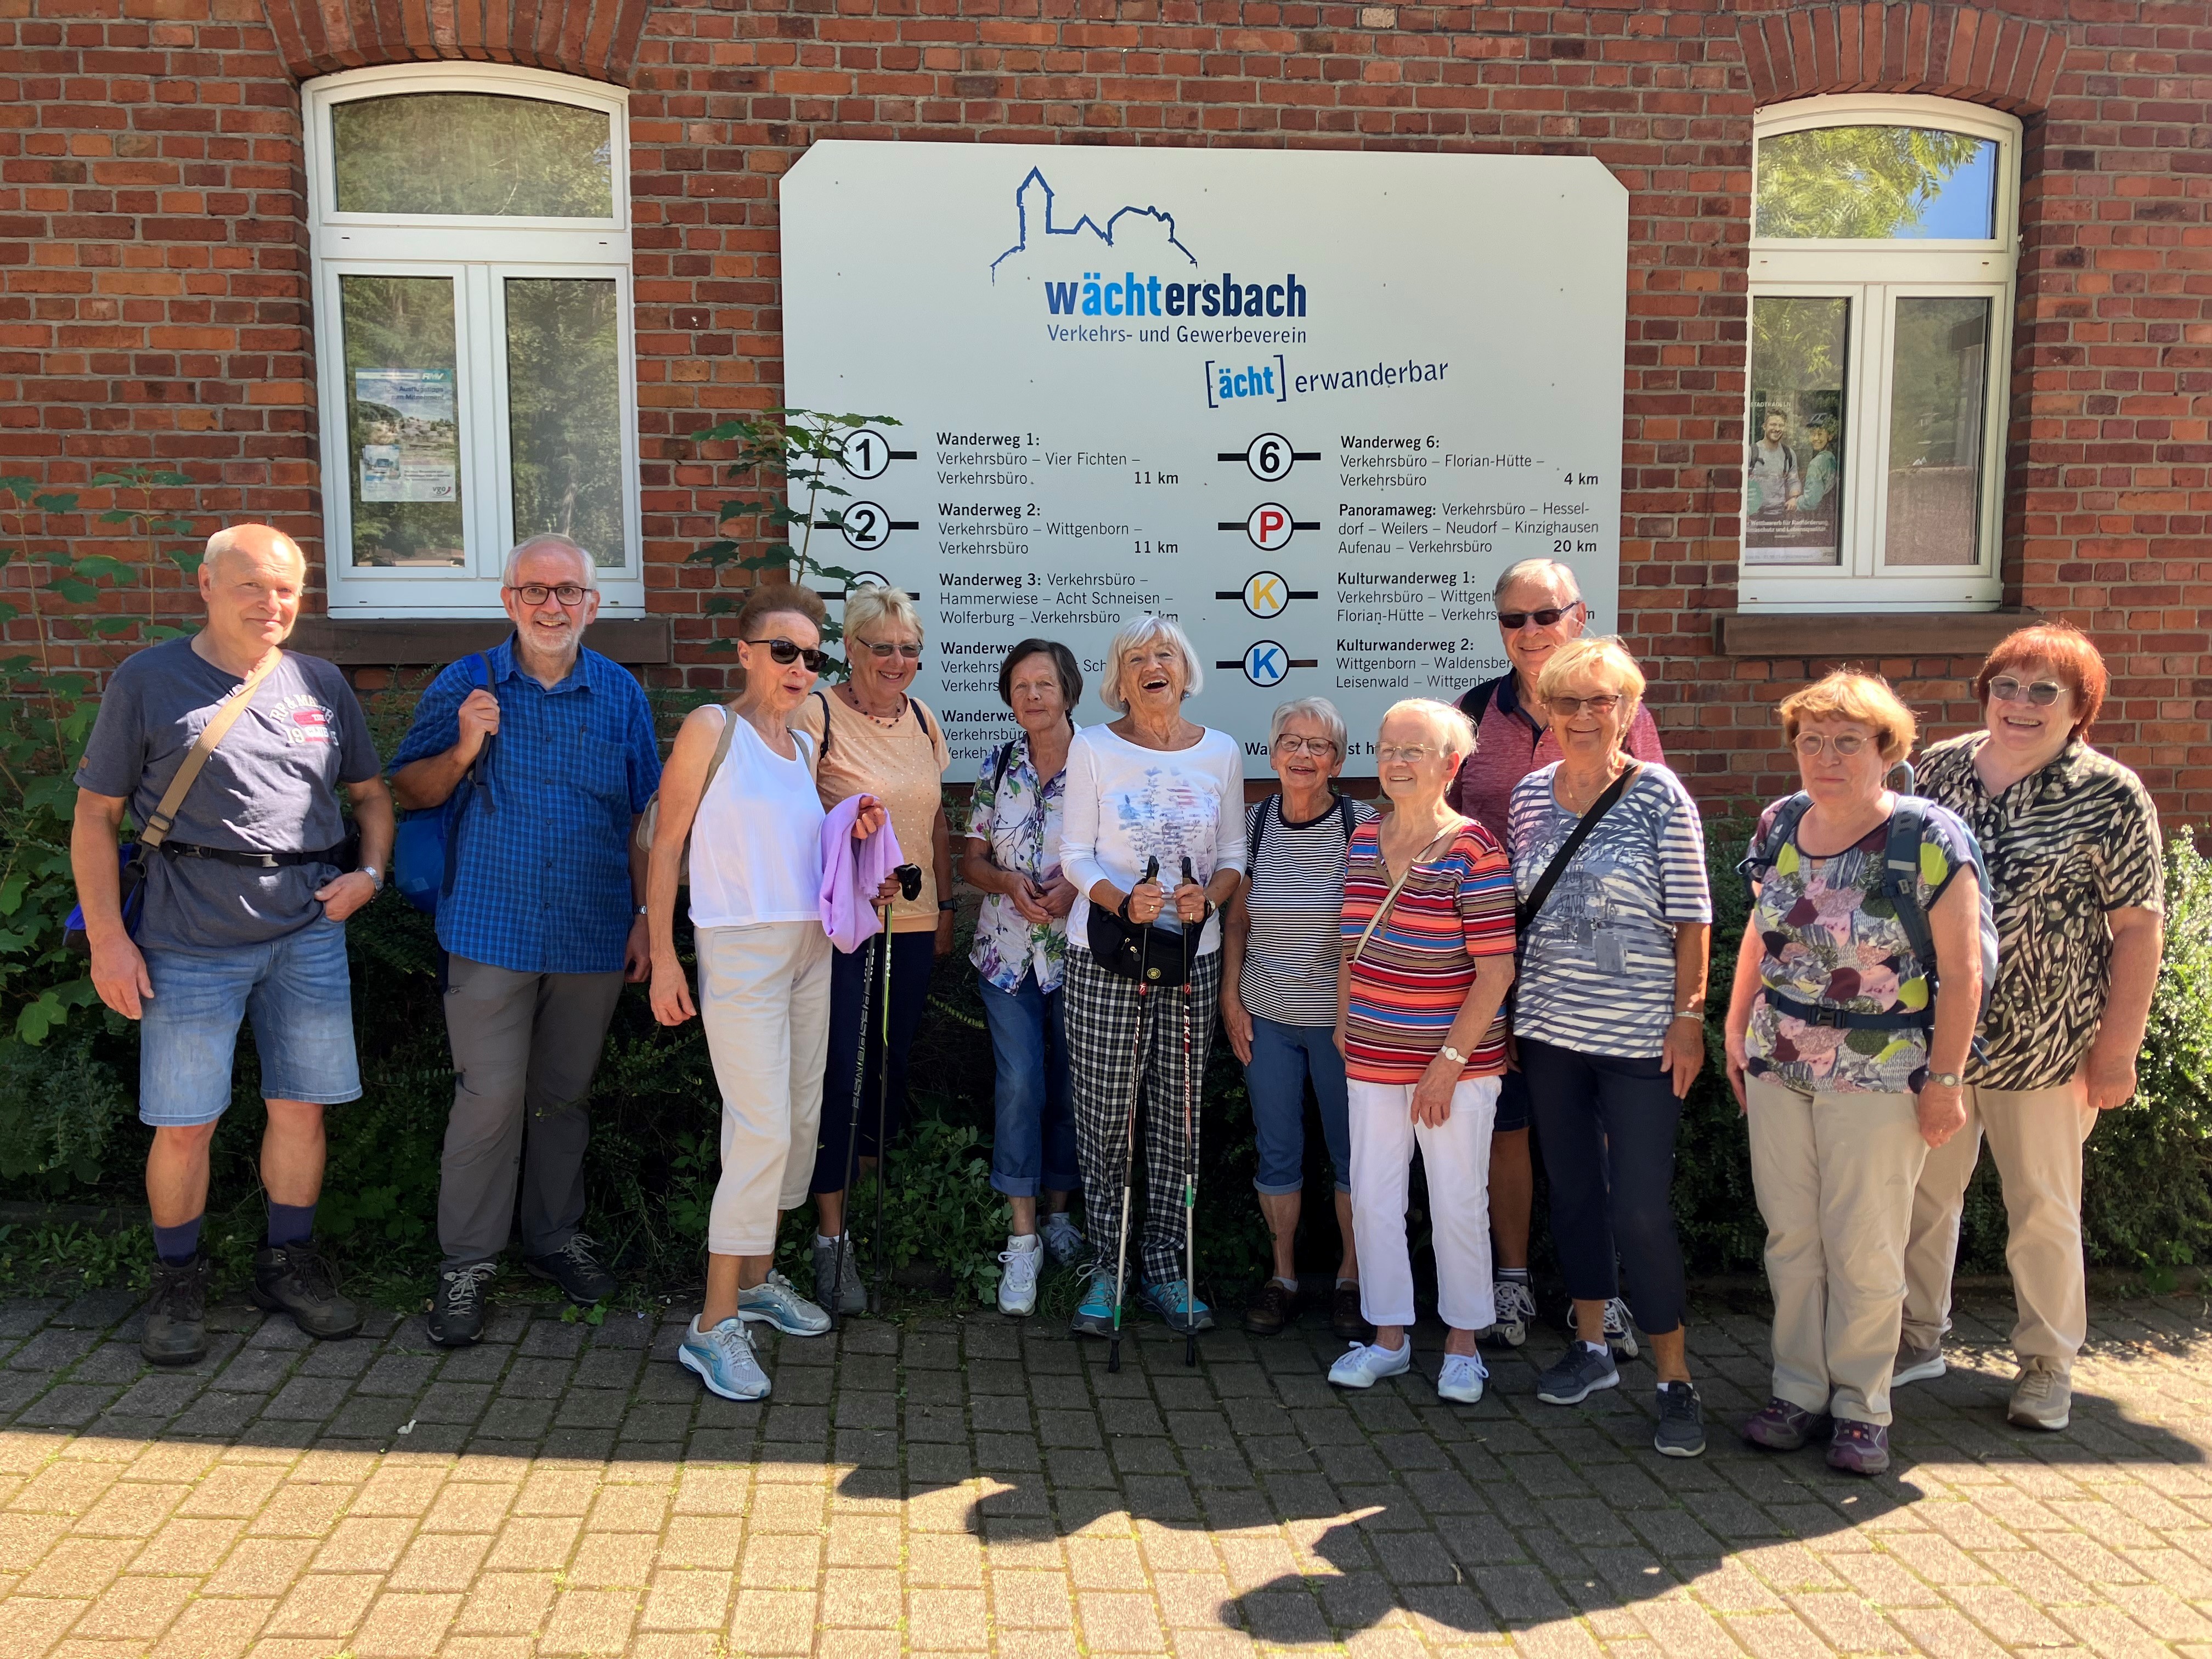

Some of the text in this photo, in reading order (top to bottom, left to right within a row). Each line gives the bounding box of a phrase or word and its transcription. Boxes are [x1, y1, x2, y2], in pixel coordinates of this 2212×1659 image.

[1044, 270, 1306, 317] wächtersbach
[1047, 324, 1306, 343] Verkehrs- und Gewerbeverein
[1205, 354, 1448, 409] [ächt] erwanderbar
[936, 432, 1039, 449] Wanderweg 1:
[1340, 435, 1439, 451] Wanderweg 6:
[856, 438, 870, 471] 1
[936, 452, 1027, 465] Verkehrsbüro
[1045, 452, 1072, 465] Vier
[1077, 452, 1127, 465] Fichten
[1259, 441, 1280, 473] 6
[1340, 454, 1427, 467] Verkehrsbüro
[1445, 454, 1532, 467] Florian-Hütte
[937, 471, 1178, 484] Verkehrsbüro 11 km
[1340, 472, 1598, 487] Verkehrsbüro 4 km
[938, 503, 1040, 519] Wanderweg 2:
[1339, 504, 1436, 518] Panoramaweg:
[1442, 502, 1525, 515] Verkehrsbüro
[1543, 502, 1589, 515] Hessel-
[855, 509, 876, 541] 2
[938, 522, 1028, 535] Verkehrsbüro
[1046, 522, 1128, 538] Wittgenborn
[1260, 511, 1284, 543] P
[1339, 522, 1364, 535] dorf
[1381, 522, 1428, 535] Weilers
[1446, 521, 1498, 534] Neudorf
[1515, 520, 1599, 536] Kinzighausen
[939, 540, 1178, 554] Verkehrsbüro 11 km
[1338, 540, 1391, 554] Aufenau
[1409, 540, 1492, 553] Verkehrsbüro
[1554, 540, 1571, 552] 20
[1577, 540, 1596, 552] km
[939, 573, 1022, 589] Wanderweg
[1027, 573, 1041, 586] 3:
[1047, 573, 1135, 586] Verkehrsbüro
[1338, 571, 1475, 586] Kulturwanderweg 1:
[940, 591, 1038, 605] Hammerwiese
[1056, 592, 1087, 605] Acht
[1092, 591, 1160, 605] Schneisen
[1253, 579, 1279, 610] K
[1337, 590, 1423, 603] Verkehrsbüro
[940, 611, 1014, 627] Wolferburg
[1032, 610, 1120, 623] Verkehrsbüro
[1338, 608, 1424, 622] Florian-Hütte
[1337, 638, 1474, 653] Kulturwanderweg 2:
[1253, 648, 1279, 679] K
[1336, 657, 1415, 673] Wittgenborn
[1434, 655, 1512, 669] Waldensber
[1336, 675, 1408, 688] Leisenwald
[942, 710, 1019, 724] Wanderwe
